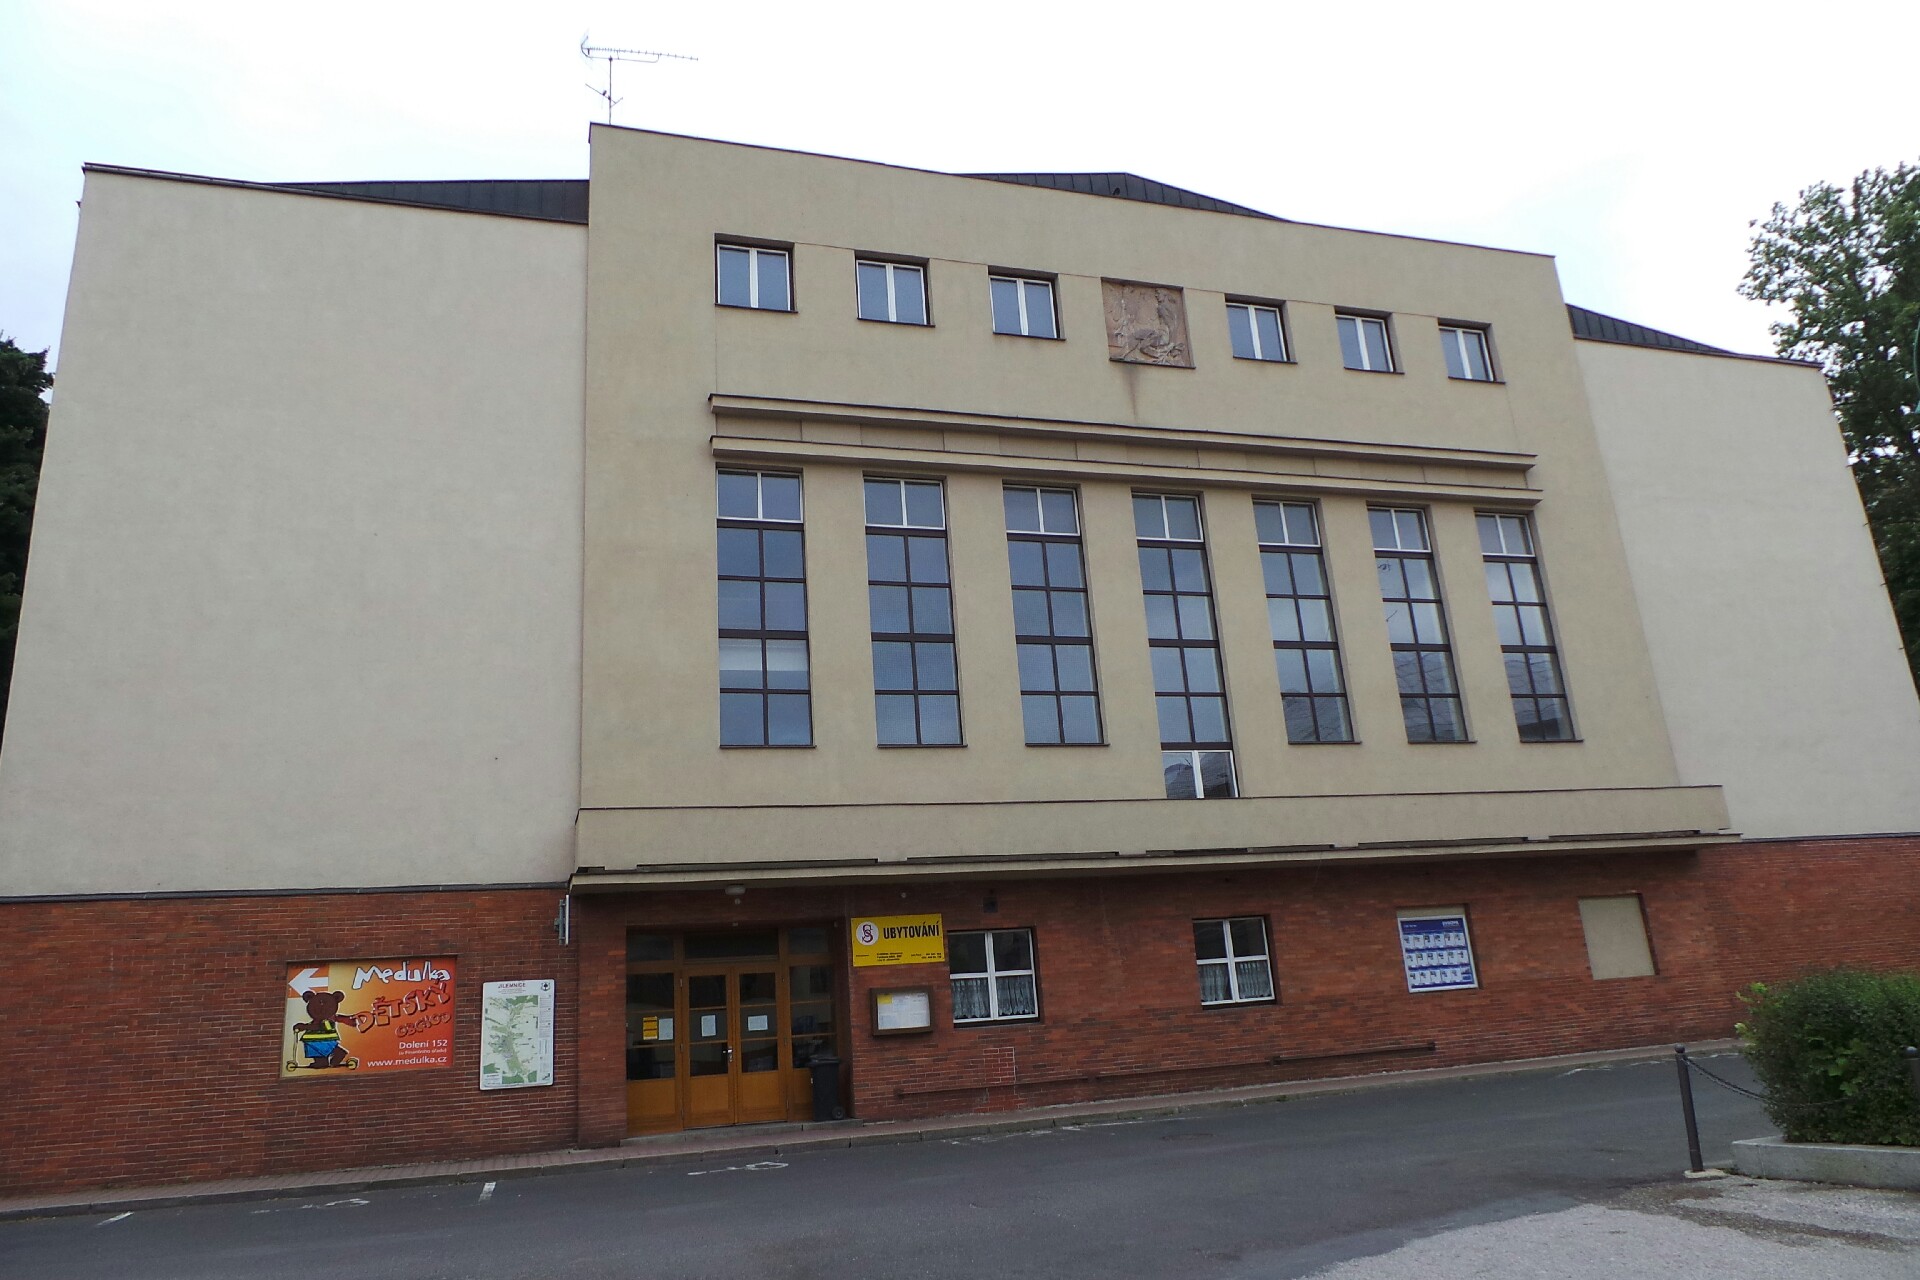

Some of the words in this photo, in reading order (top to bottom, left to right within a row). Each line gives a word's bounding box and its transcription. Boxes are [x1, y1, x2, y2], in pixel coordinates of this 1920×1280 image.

[883, 921, 939, 939] UBYTOVÁNÍ
[354, 980, 451, 1034] DĚTSKÝ
[395, 1012, 452, 1038] OBCHOD
[399, 1040, 429, 1050] Dolení
[432, 1039, 448, 1047] 152
[367, 1055, 448, 1068] www.medulka.cz
